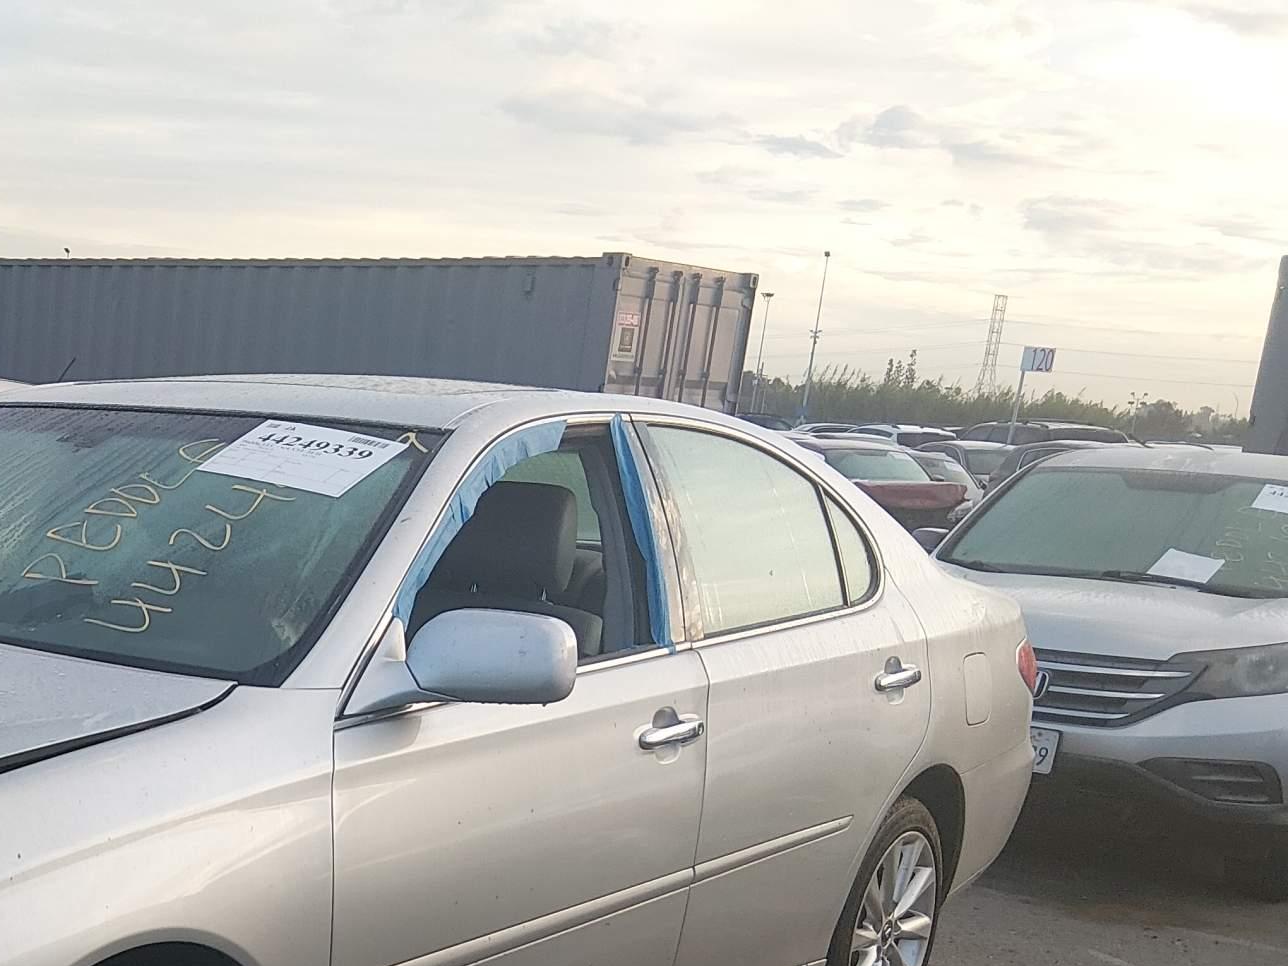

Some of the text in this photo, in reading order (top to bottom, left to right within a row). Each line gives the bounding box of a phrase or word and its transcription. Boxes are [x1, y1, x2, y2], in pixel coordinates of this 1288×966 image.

[1031, 347, 1056, 372] 120
[257, 432, 374, 460] 44249339
[83, 483, 297, 634] 4424
